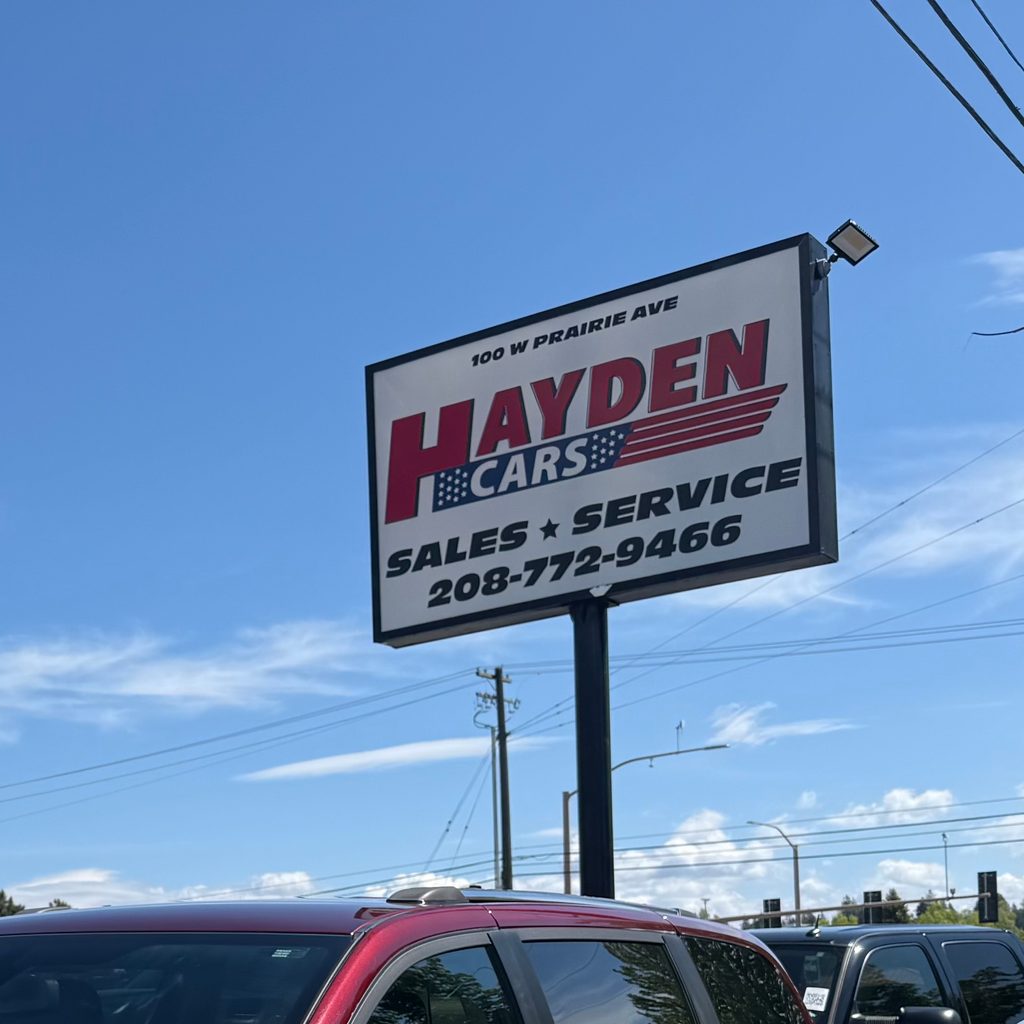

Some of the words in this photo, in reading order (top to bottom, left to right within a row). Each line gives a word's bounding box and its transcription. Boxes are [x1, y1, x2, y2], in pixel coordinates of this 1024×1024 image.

[472, 346, 505, 366] 100
[510, 340, 530, 356] W
[533, 311, 628, 351] PRAIRIE
[631, 296, 679, 322] AVE
[385, 319, 770, 524] HAYDEN
[470, 435, 590, 498] CARS
[385, 520, 528, 578] SALES
[571, 457, 803, 535] SERVICE
[427, 514, 743, 608] 208-772-9466
